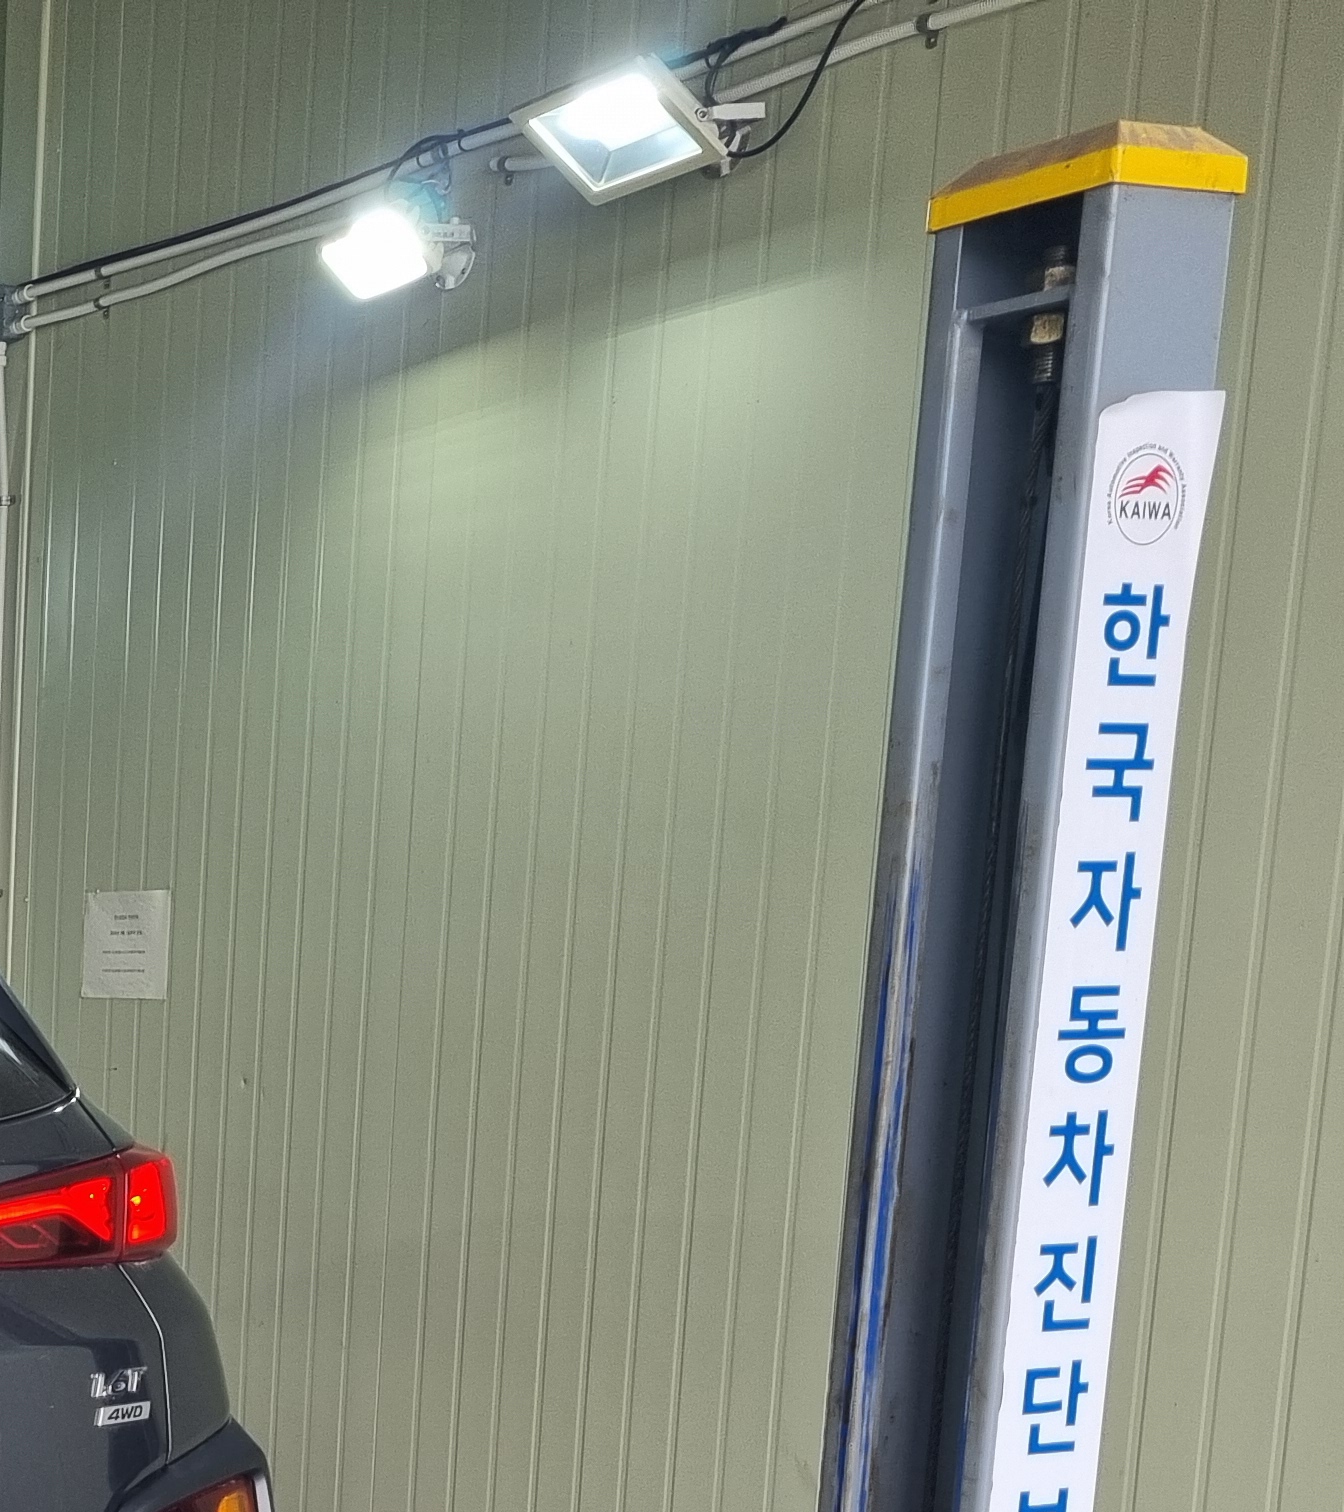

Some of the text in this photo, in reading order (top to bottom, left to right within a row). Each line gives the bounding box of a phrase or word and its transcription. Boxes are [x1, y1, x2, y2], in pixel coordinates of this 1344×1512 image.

[1119, 500, 1171, 520] KAIWA
[90, 1366, 148, 1398] 1.6T
[107, 1405, 143, 1421] 4WD
